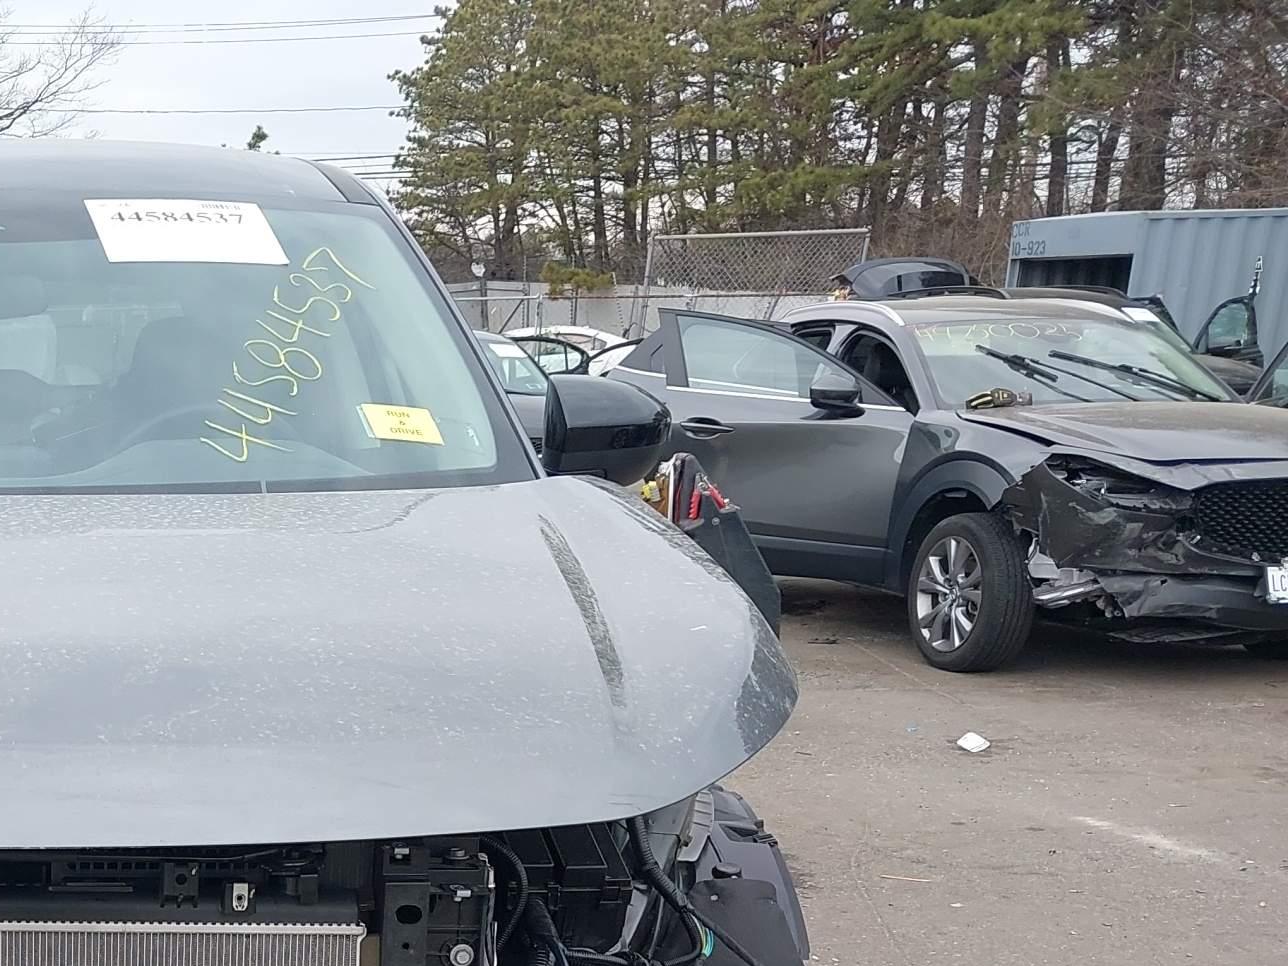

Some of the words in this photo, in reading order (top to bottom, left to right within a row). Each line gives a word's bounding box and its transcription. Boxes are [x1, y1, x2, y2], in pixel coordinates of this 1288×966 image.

[110, 211, 243, 225] 44584537
[199, 247, 377, 462] 44584537
[385, 410, 411, 418] RUN
[390, 427, 424, 436] DRIVE
